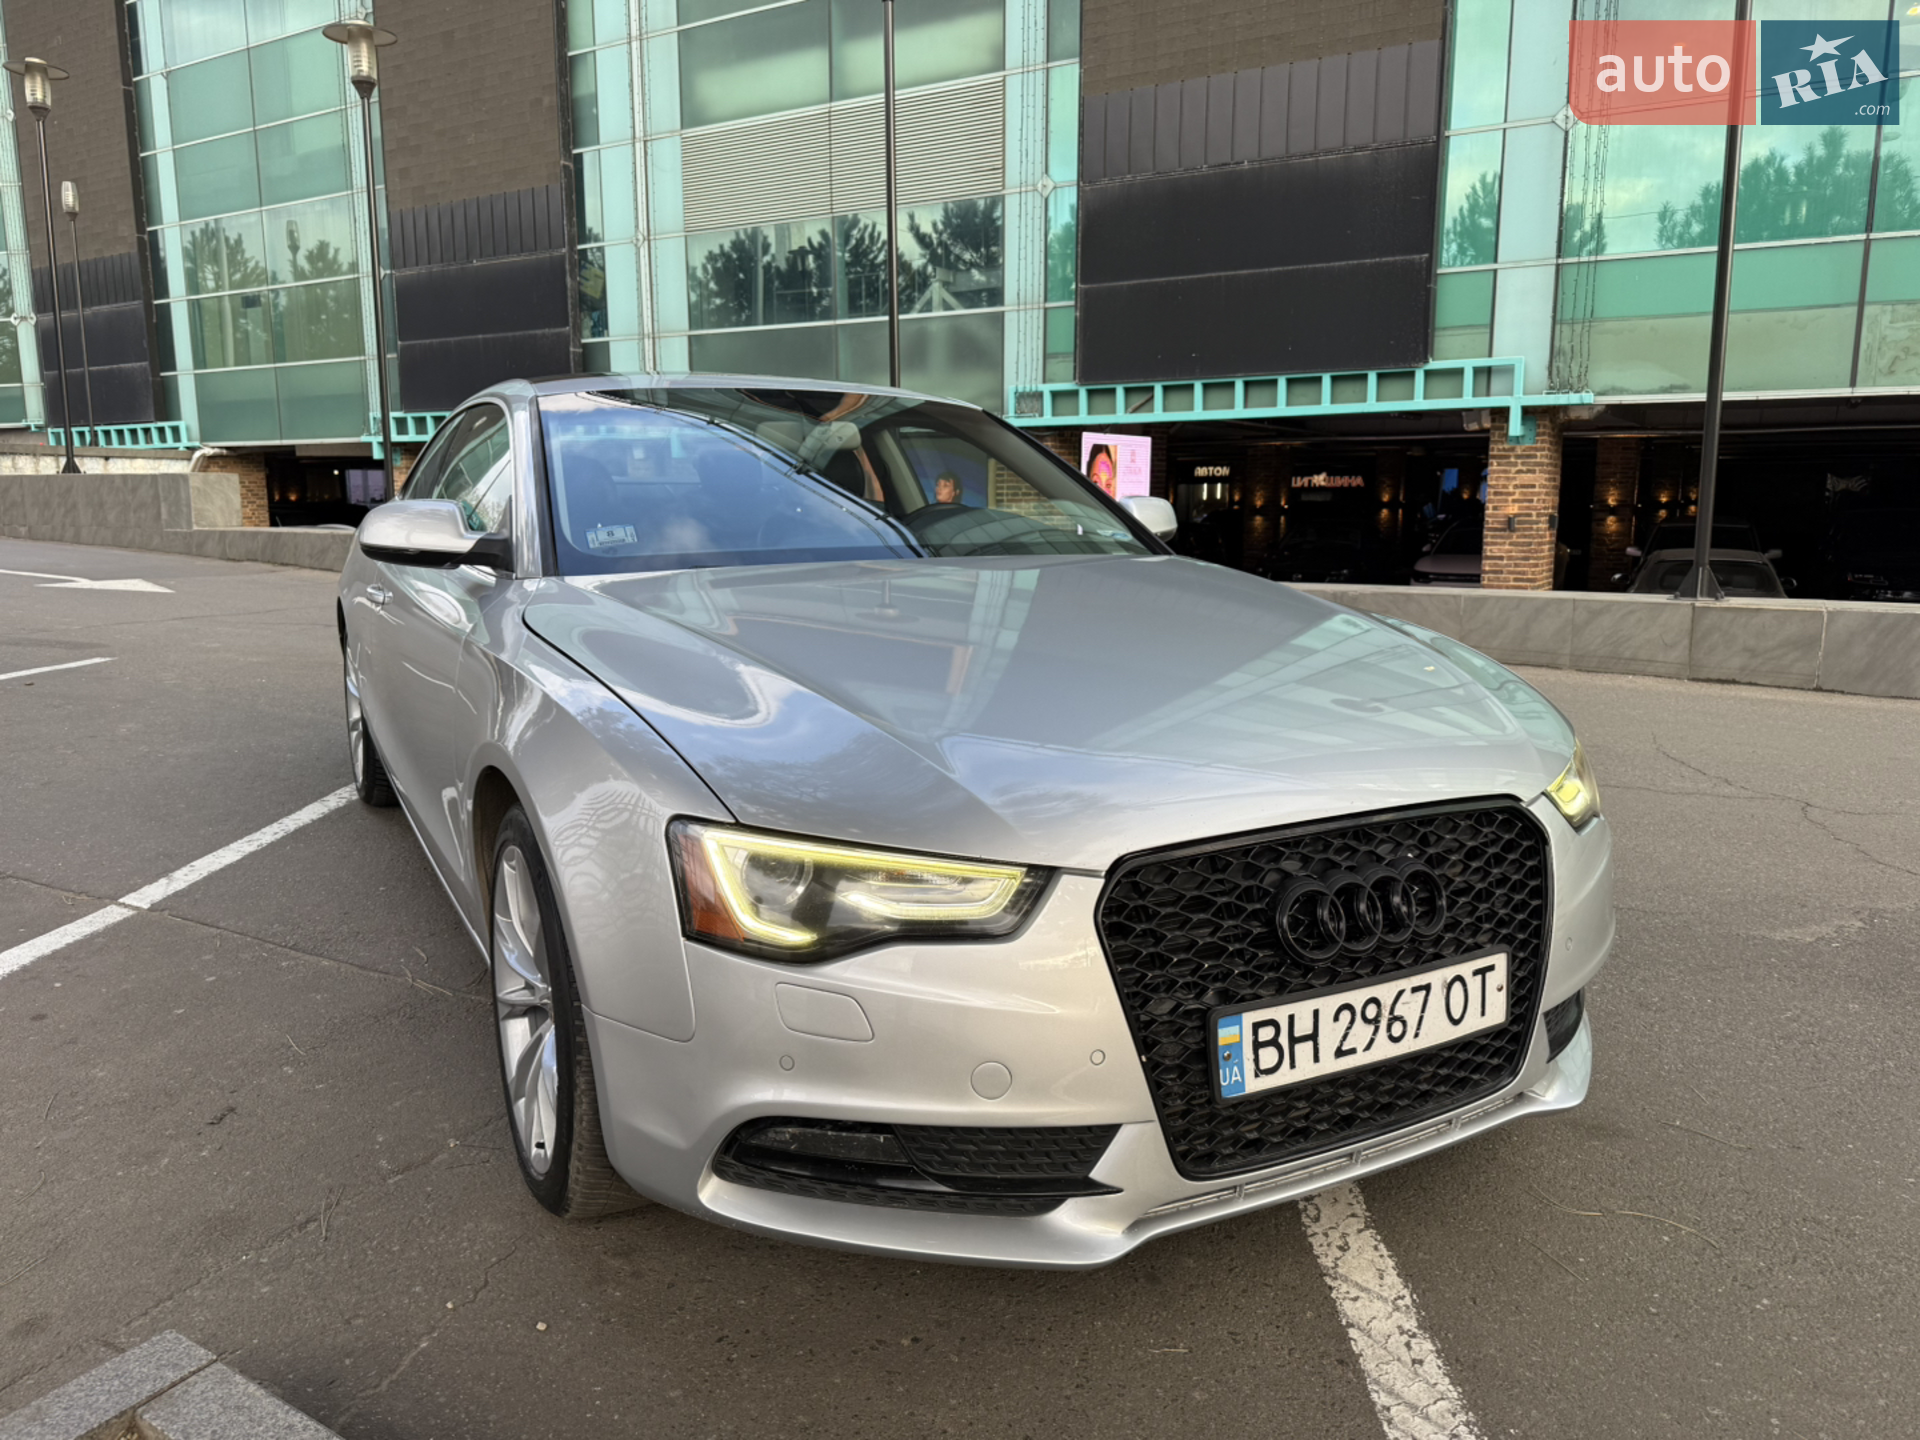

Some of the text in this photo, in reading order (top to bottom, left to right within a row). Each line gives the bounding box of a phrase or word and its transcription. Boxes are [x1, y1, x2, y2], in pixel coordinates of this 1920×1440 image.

[1252, 963, 1496, 1079] BH 2967 OT
[1219, 1067, 1242, 1086] UA
